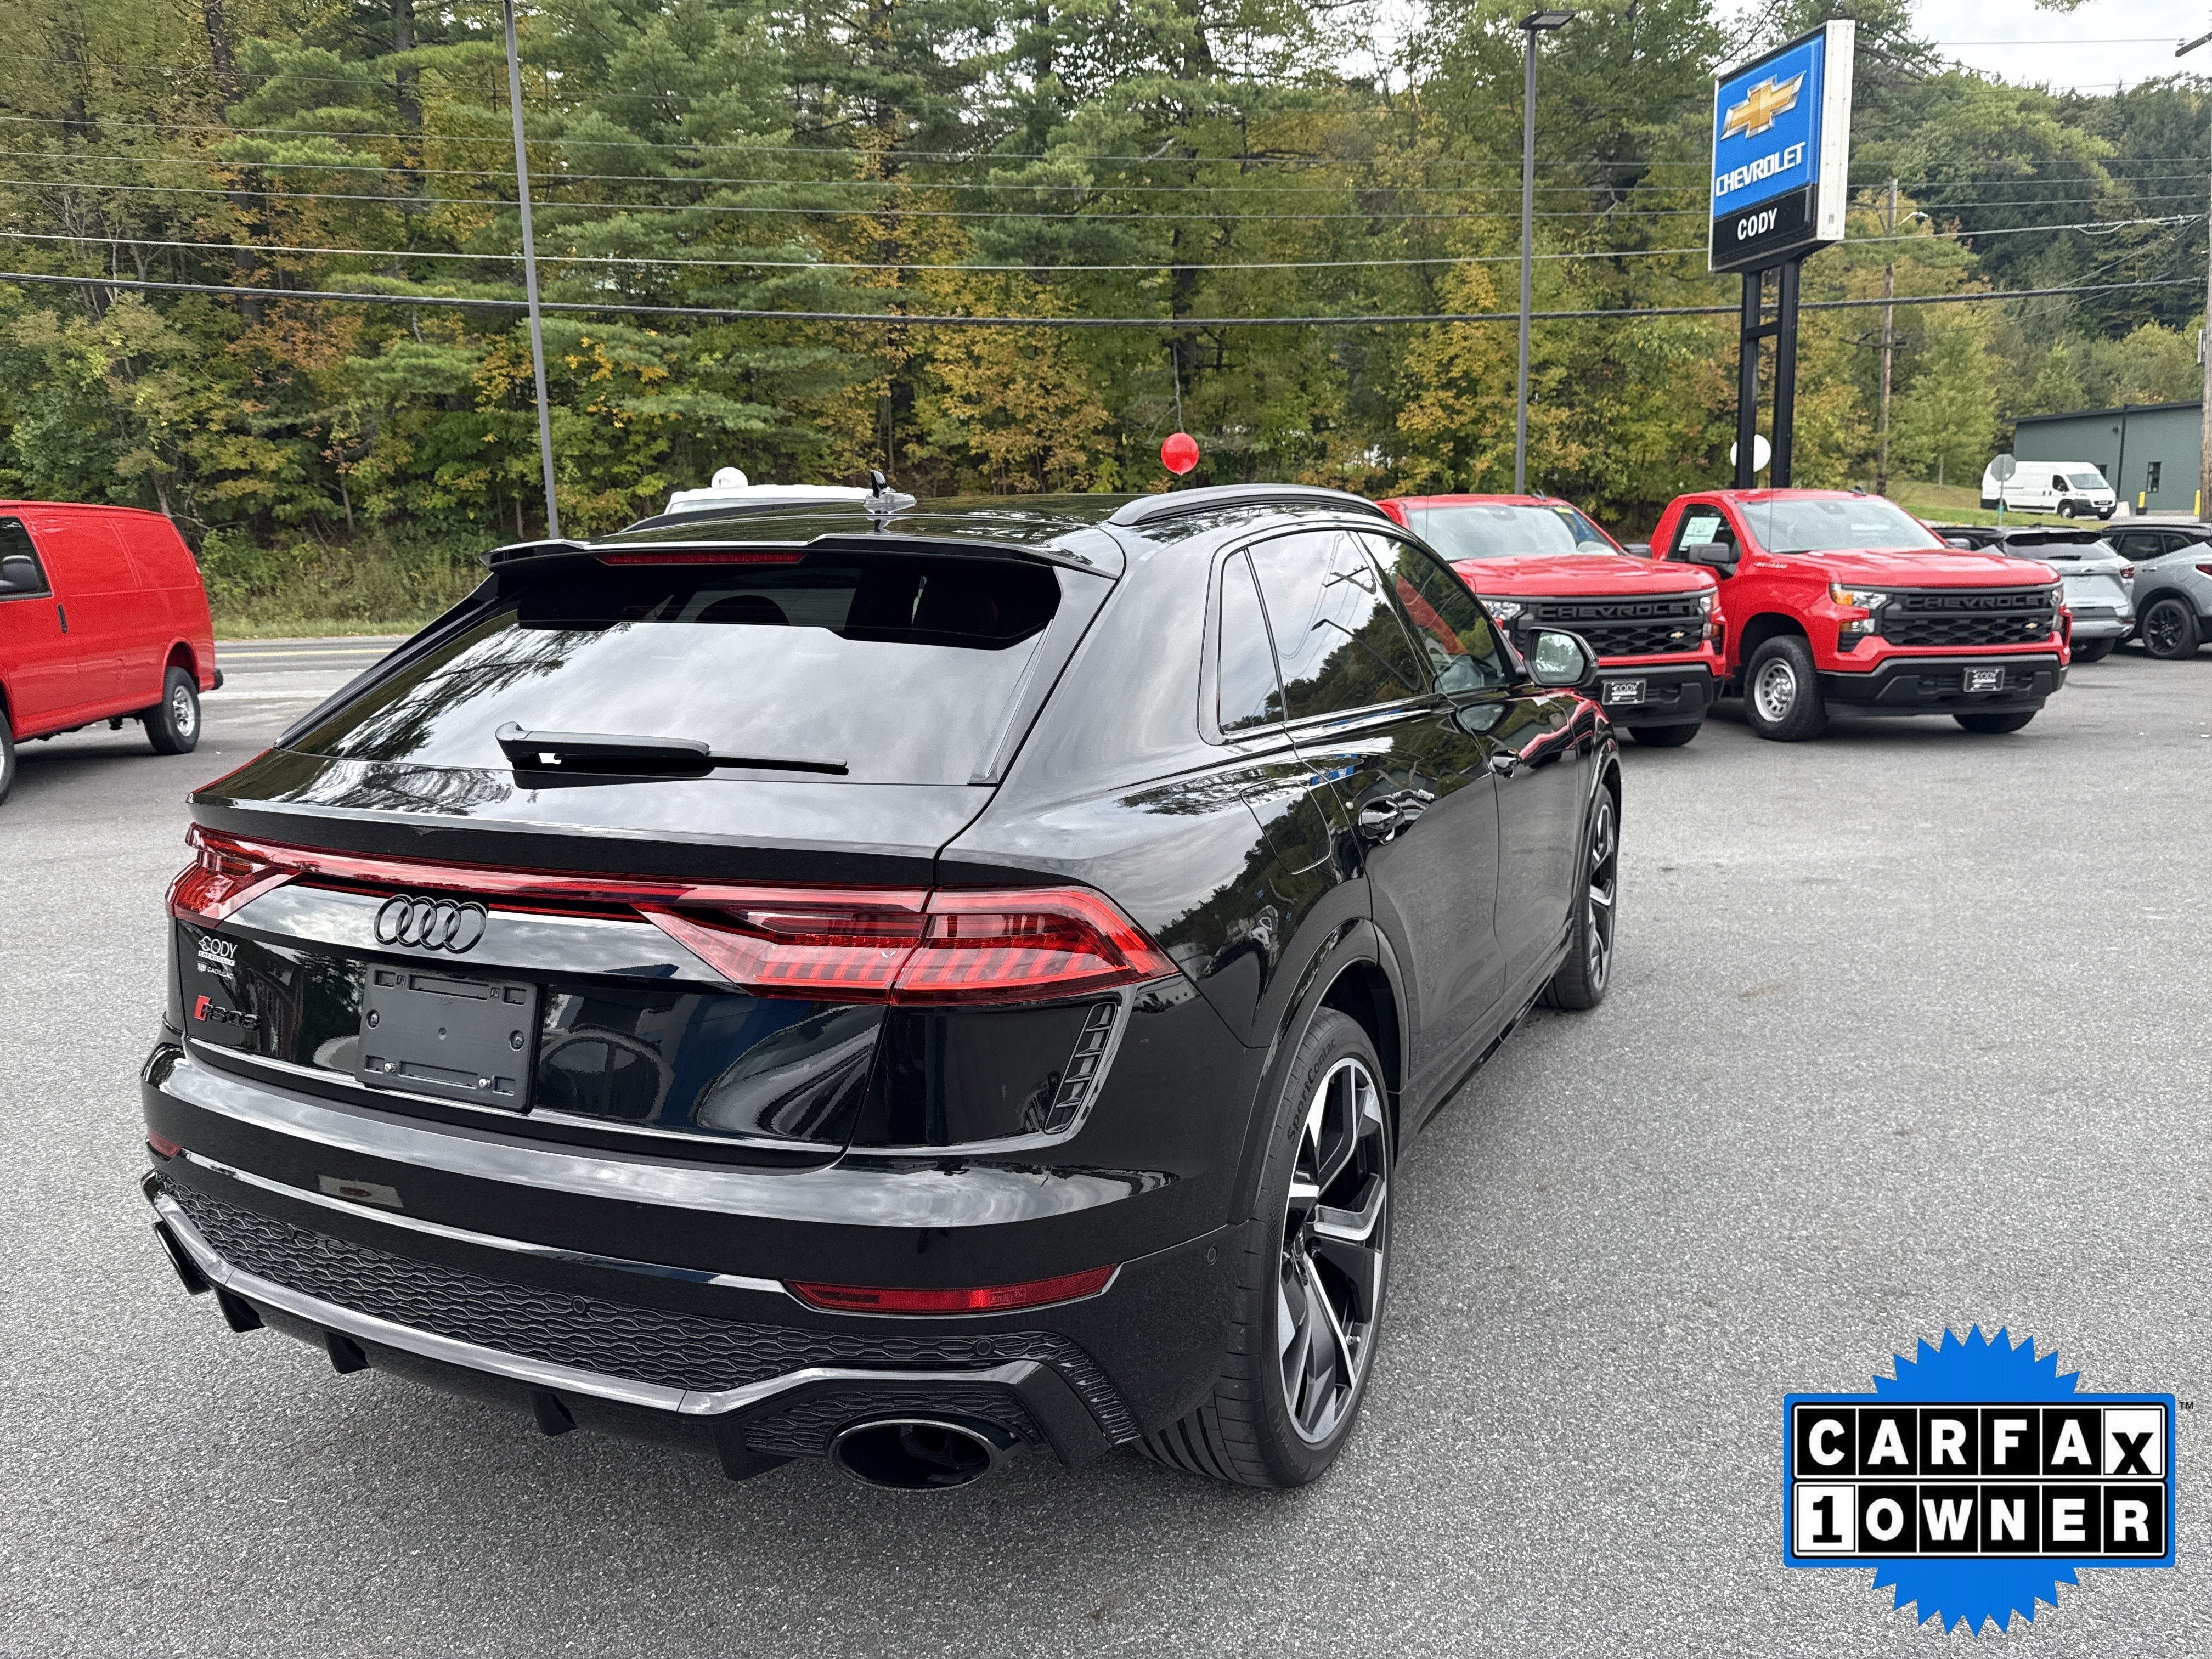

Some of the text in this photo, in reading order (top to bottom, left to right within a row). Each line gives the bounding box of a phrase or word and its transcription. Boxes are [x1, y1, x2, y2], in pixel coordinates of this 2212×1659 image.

[1716, 141, 1806, 198] CHEVROLET
[1737, 207, 1778, 241] CODY
[1538, 602, 1699, 618] CHEVROLET
[198, 935, 238, 959] CODY
[207, 966, 234, 979] CADILLAC
